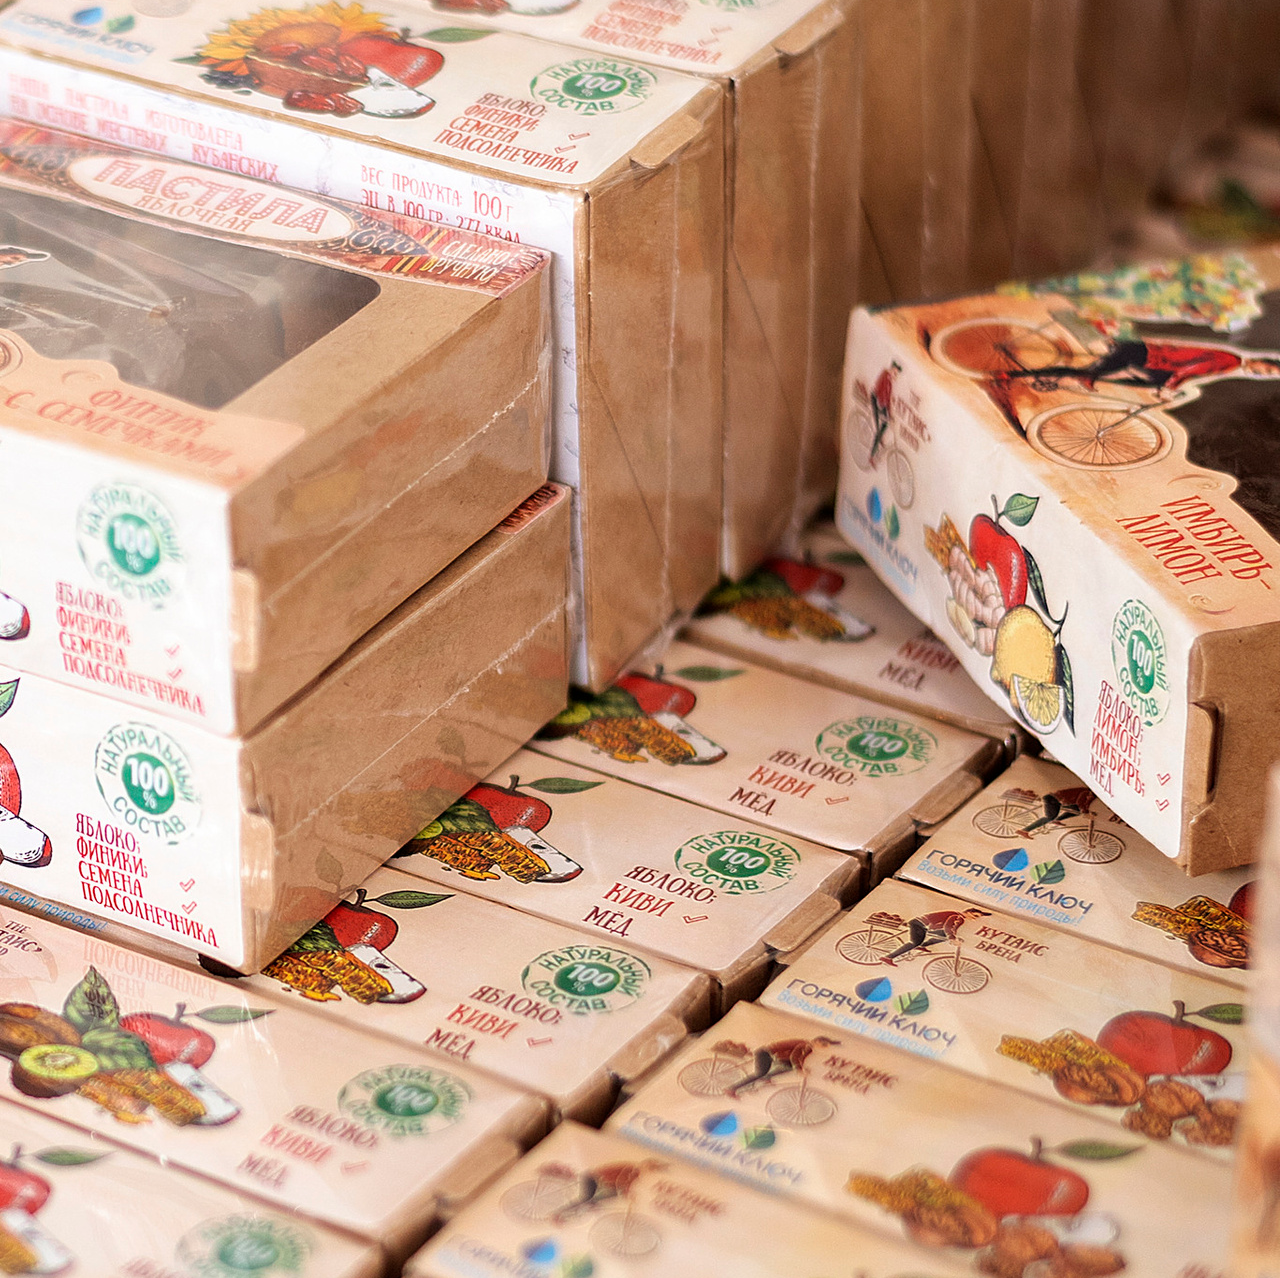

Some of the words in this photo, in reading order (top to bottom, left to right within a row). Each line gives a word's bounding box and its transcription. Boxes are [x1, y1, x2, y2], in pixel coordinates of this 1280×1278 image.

[547, 61, 653, 99] НАТУРАЛЬНЫЙ
[574, 74, 621, 92] 100
[476, 93, 547, 117] ЯБЛОКО;
[450, 116, 519, 143] СЕМЕНА
[433, 129, 579, 174] ПОДСОЛНЕЧНИКА
[94, 158, 330, 235] ПАСТИЛА
[361, 164, 385, 187] ВЕС
[391, 173, 463, 208] ПРОДУКТА:
[473, 190, 502, 219] 100
[403, 199, 424, 219] 100
[134, 194, 255, 234] ЯБЛОЧНАЯ
[419, 255, 499, 284] ВРУЧНУЮ
[442, 241, 510, 265] СДЕЛАНО
[1115, 514, 1223, 586] ЛИМОН
[1160, 495, 1272, 589] ИМБИРЬ-
[59, 631, 127, 667] СЕМЕНА
[1115, 606, 1169, 692] НАТУРАЛЬНЫЙ
[1131, 635, 1152, 676] 100
[62, 653, 206, 716] ПОДСОЛНЕЧНИКА
[1098, 680, 1143, 742] ЯБЛОКО;
[831, 716, 934, 763] НАТУРАЛЬНЫЙ
[860, 733, 903, 752] 100
[1093, 703, 1141, 766] ЛИМОН;
[102, 729, 201, 803] НАТУРАЛЬНЫЙ
[127, 758, 168, 797] 100
[769, 751, 857, 786] ЯБЛОКО;
[1091, 727, 1145, 797] ИМБИРЬ;
[748, 765, 817, 800] КИВИ
[76, 813, 140, 853] ЯБЛОКО;
[114, 796, 185, 837] СОСТАВ
[77, 836, 148, 878] ФИНИКИ;
[691, 833, 795, 879] НАТУРАЛЬНЫЙ
[719, 848, 765, 869] 100
[79, 860, 143, 898] СЕМЕНА
[624, 865, 717, 905] ЯБЛОКО;
[917, 859, 972, 888] Возьми
[974, 882, 1009, 903] силу
[1010, 896, 1086, 927] природы!
[926, 849, 1026, 892] ГОРЯЧИЙ
[1026, 883, 1094, 915] КЛЮЧ
[8, 890, 40, 913] силу
[39, 900, 108, 932] природы!
[81, 881, 219, 948] ПОДСОЛНЕЧНИКА
[603, 882, 675, 918] КИВИ
[5, 919, 28, 935] THE
[974, 925, 1050, 957] КУТАИС
[539, 948, 646, 997] НАТУРАЛЬНЫЙ
[975, 941, 1022, 964] БРЕНД
[567, 964, 614, 986] 100
[446, 1003, 521, 1040] КИВИ
[468, 985, 563, 1024] ЯБЛОКО;
[787, 978, 889, 1022] ГОРЯЧИЙ
[888, 1015, 957, 1046] КЛЮЧ
